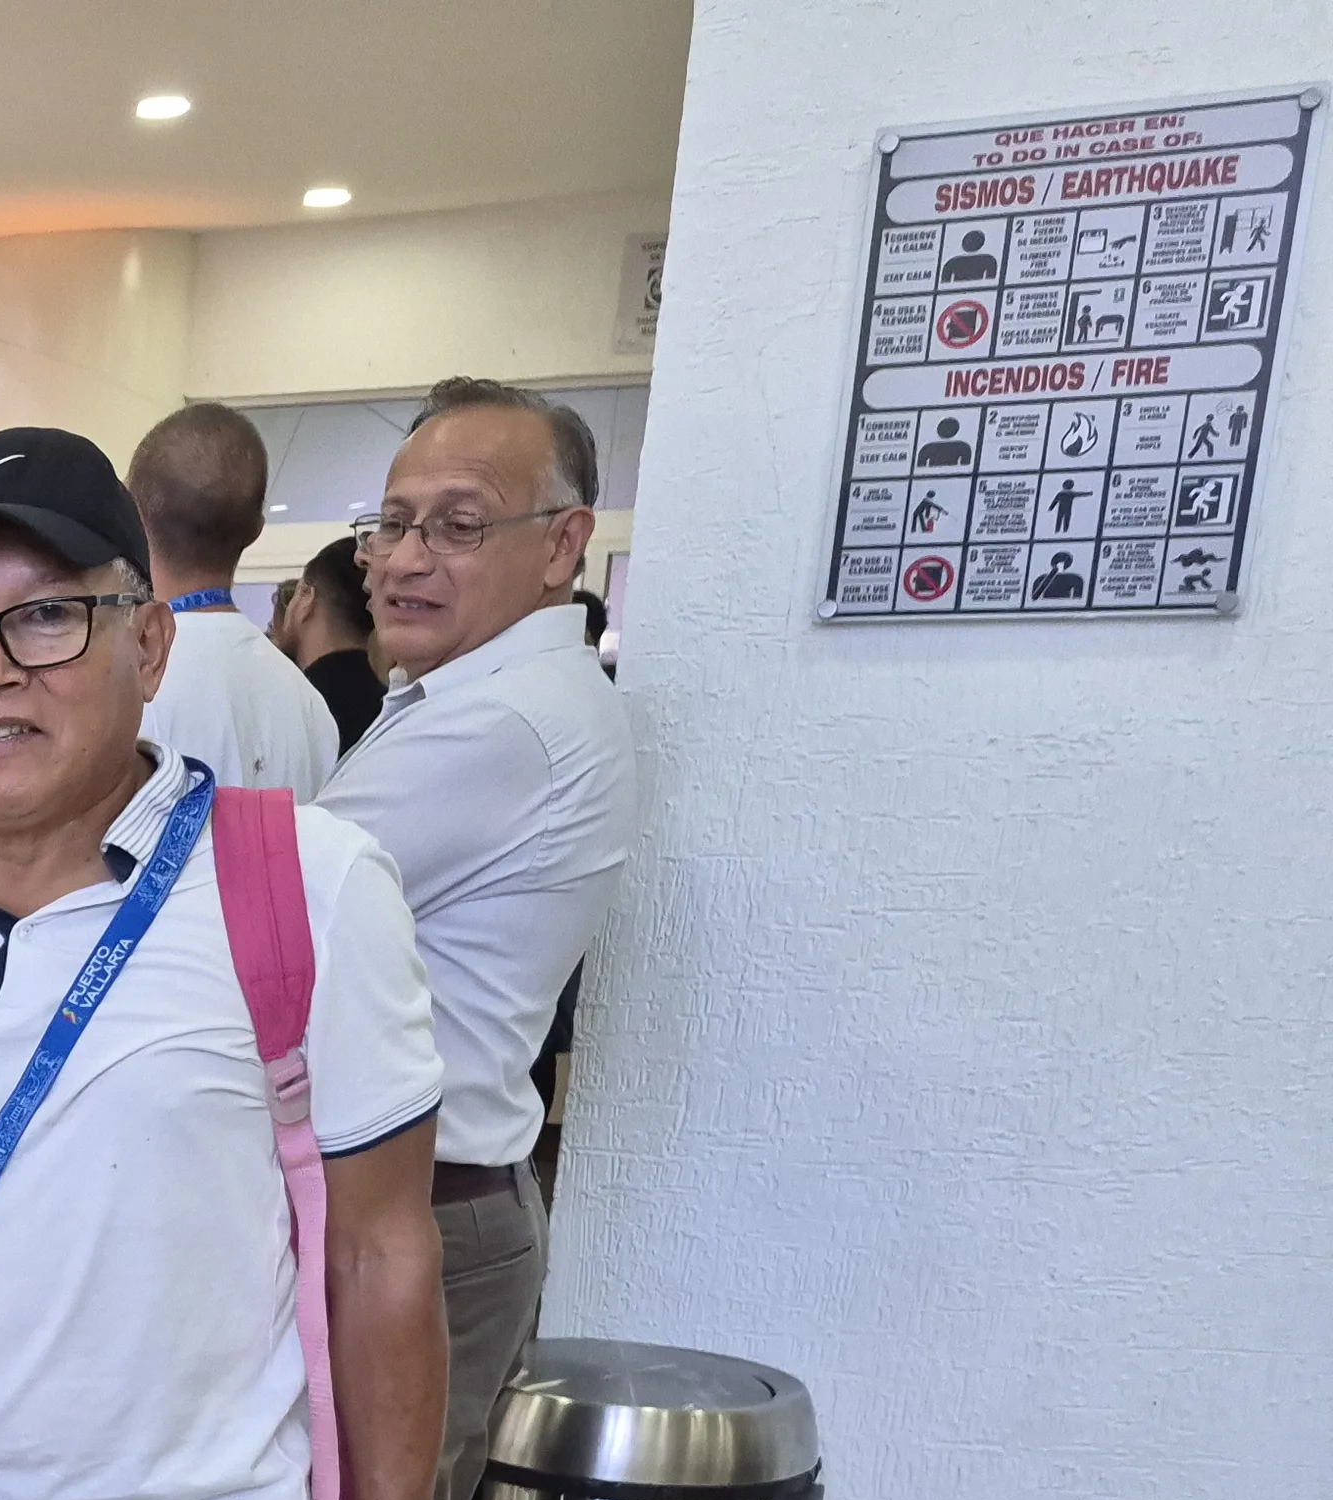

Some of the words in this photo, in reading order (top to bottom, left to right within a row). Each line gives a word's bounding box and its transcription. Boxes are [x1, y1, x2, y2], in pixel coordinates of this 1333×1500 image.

[995, 130, 1044, 147] QUE
[1053, 119, 1134, 139] HACER
[973, 151, 1003, 168] TO
[1012, 145, 1047, 163] DO
[1055, 141, 1081, 158] IN
[1089, 135, 1155, 155] CASE
[934, 173, 1036, 213] SISMOS
[1060, 154, 1240, 201] EARTHQUAKE
[1014, 219, 1025, 233] 2
[890, 230, 937, 244] CONSERVE
[902, 242, 933, 253] CALMA
[906, 270, 932, 281] CALM
[1142, 280, 1152, 294] 6
[944, 361, 1086, 398] INCENDIOS
[1110, 355, 1171, 388] FIRE
[988, 410, 998, 424] 2
[1123, 402, 1133, 417] 3
[68, 946, 110, 1006] PUERTO
[79, 939, 133, 1008] VALLARTA
